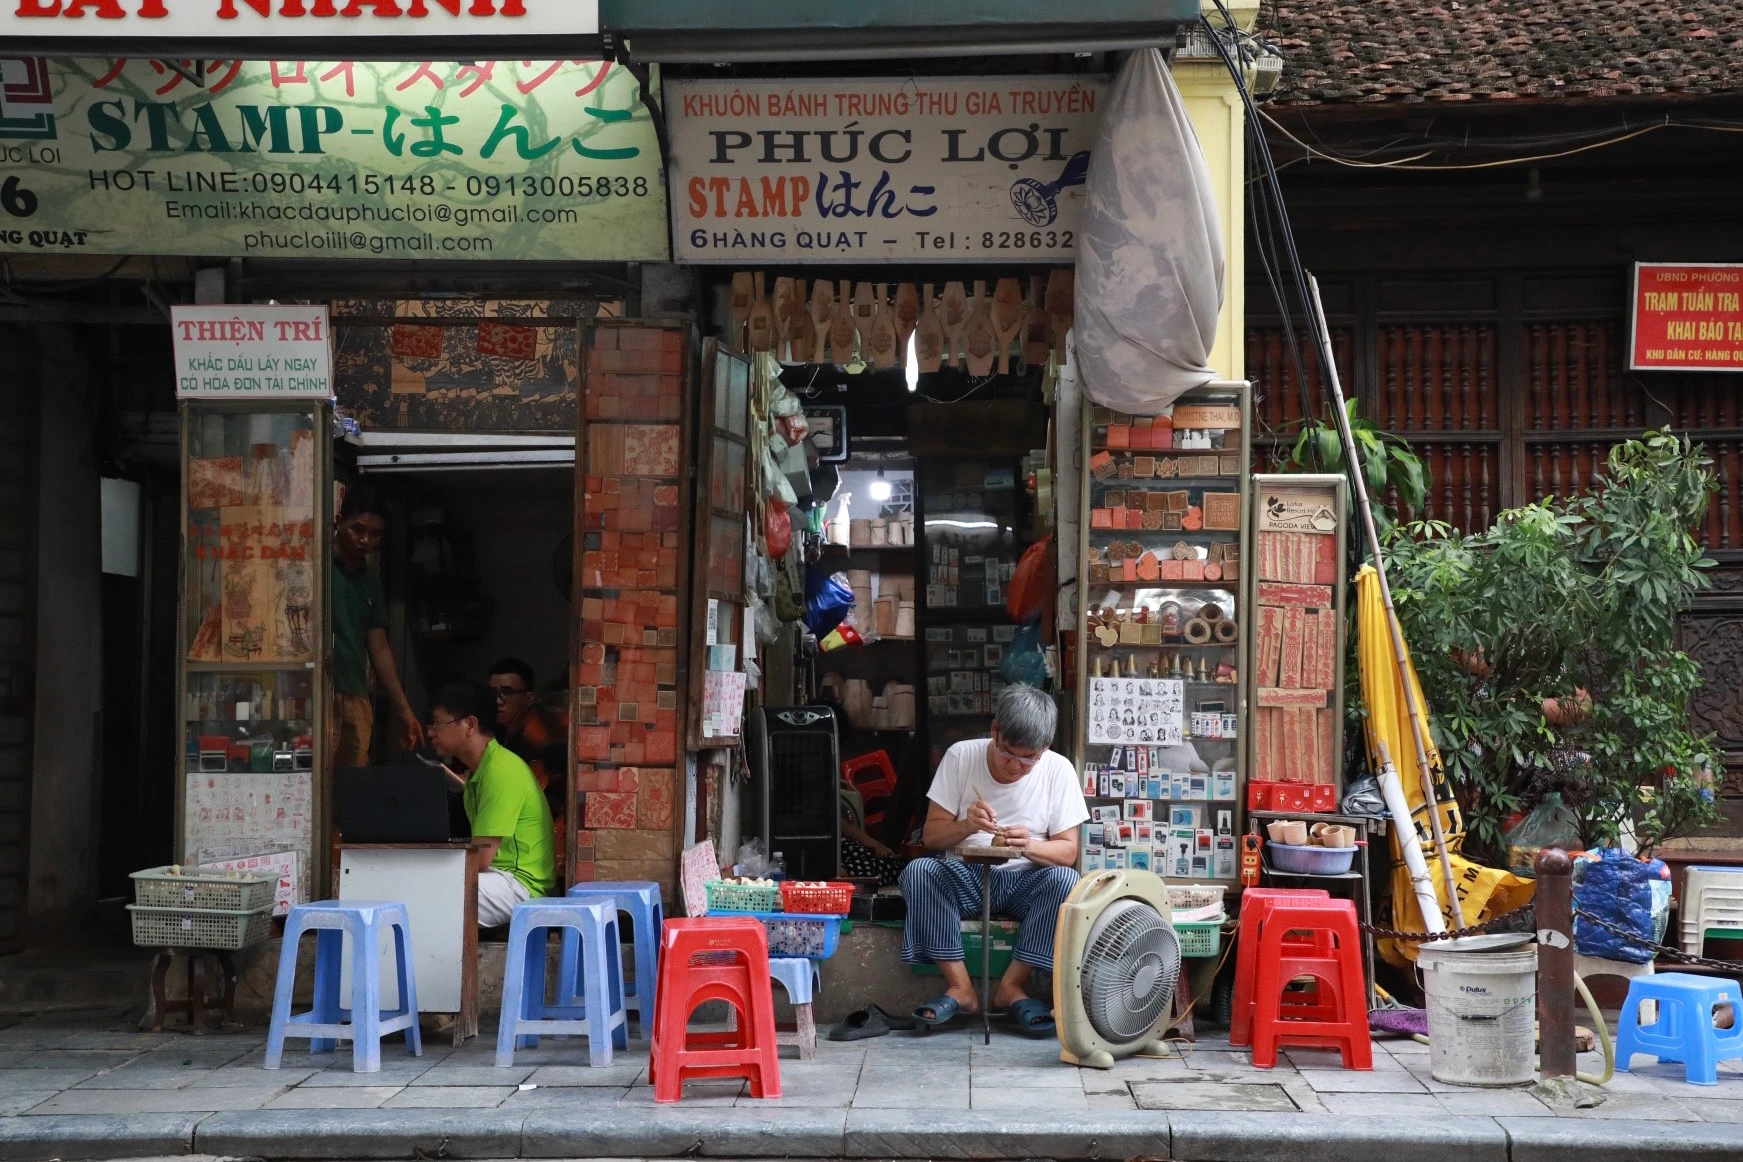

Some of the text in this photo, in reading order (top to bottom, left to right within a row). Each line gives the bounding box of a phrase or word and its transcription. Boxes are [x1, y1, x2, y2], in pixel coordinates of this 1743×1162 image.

[684, 82, 1096, 117] KHUÔN BÁNH TRUNG THU GIA TRUYỀN
[709, 121, 1069, 170] PHÚC LỢI
[29, 147, 61, 164] LOI
[89, 169, 155, 191] HOT
[466, 176, 649, 197] 0913005838
[1, 175, 38, 218] 6
[28, 230, 87, 248] QUẠT
[796, 231, 868, 252] QUẠT
[1656, 272, 1688, 281] UBND
[1644, 292, 1679, 316] TRẠM
[1717, 292, 1740, 312] TRA
[177, 316, 322, 346] THIỆN TRÍ
[1667, 317, 1743, 345] KHAI BÁO TẠ
[1646, 349, 1664, 360] KHU
[1667, 348, 1685, 360] DÂN
[1705, 348, 1730, 361] HÀNG
[284, 358, 317, 371] NGAY
[180, 373, 198, 390] CÓ
[203, 373, 230, 390] HÓA
[288, 373, 327, 390] CHÍNH
[1269, 521, 1298, 529] PAGODA
[1465, 985, 1487, 993] Dulux
